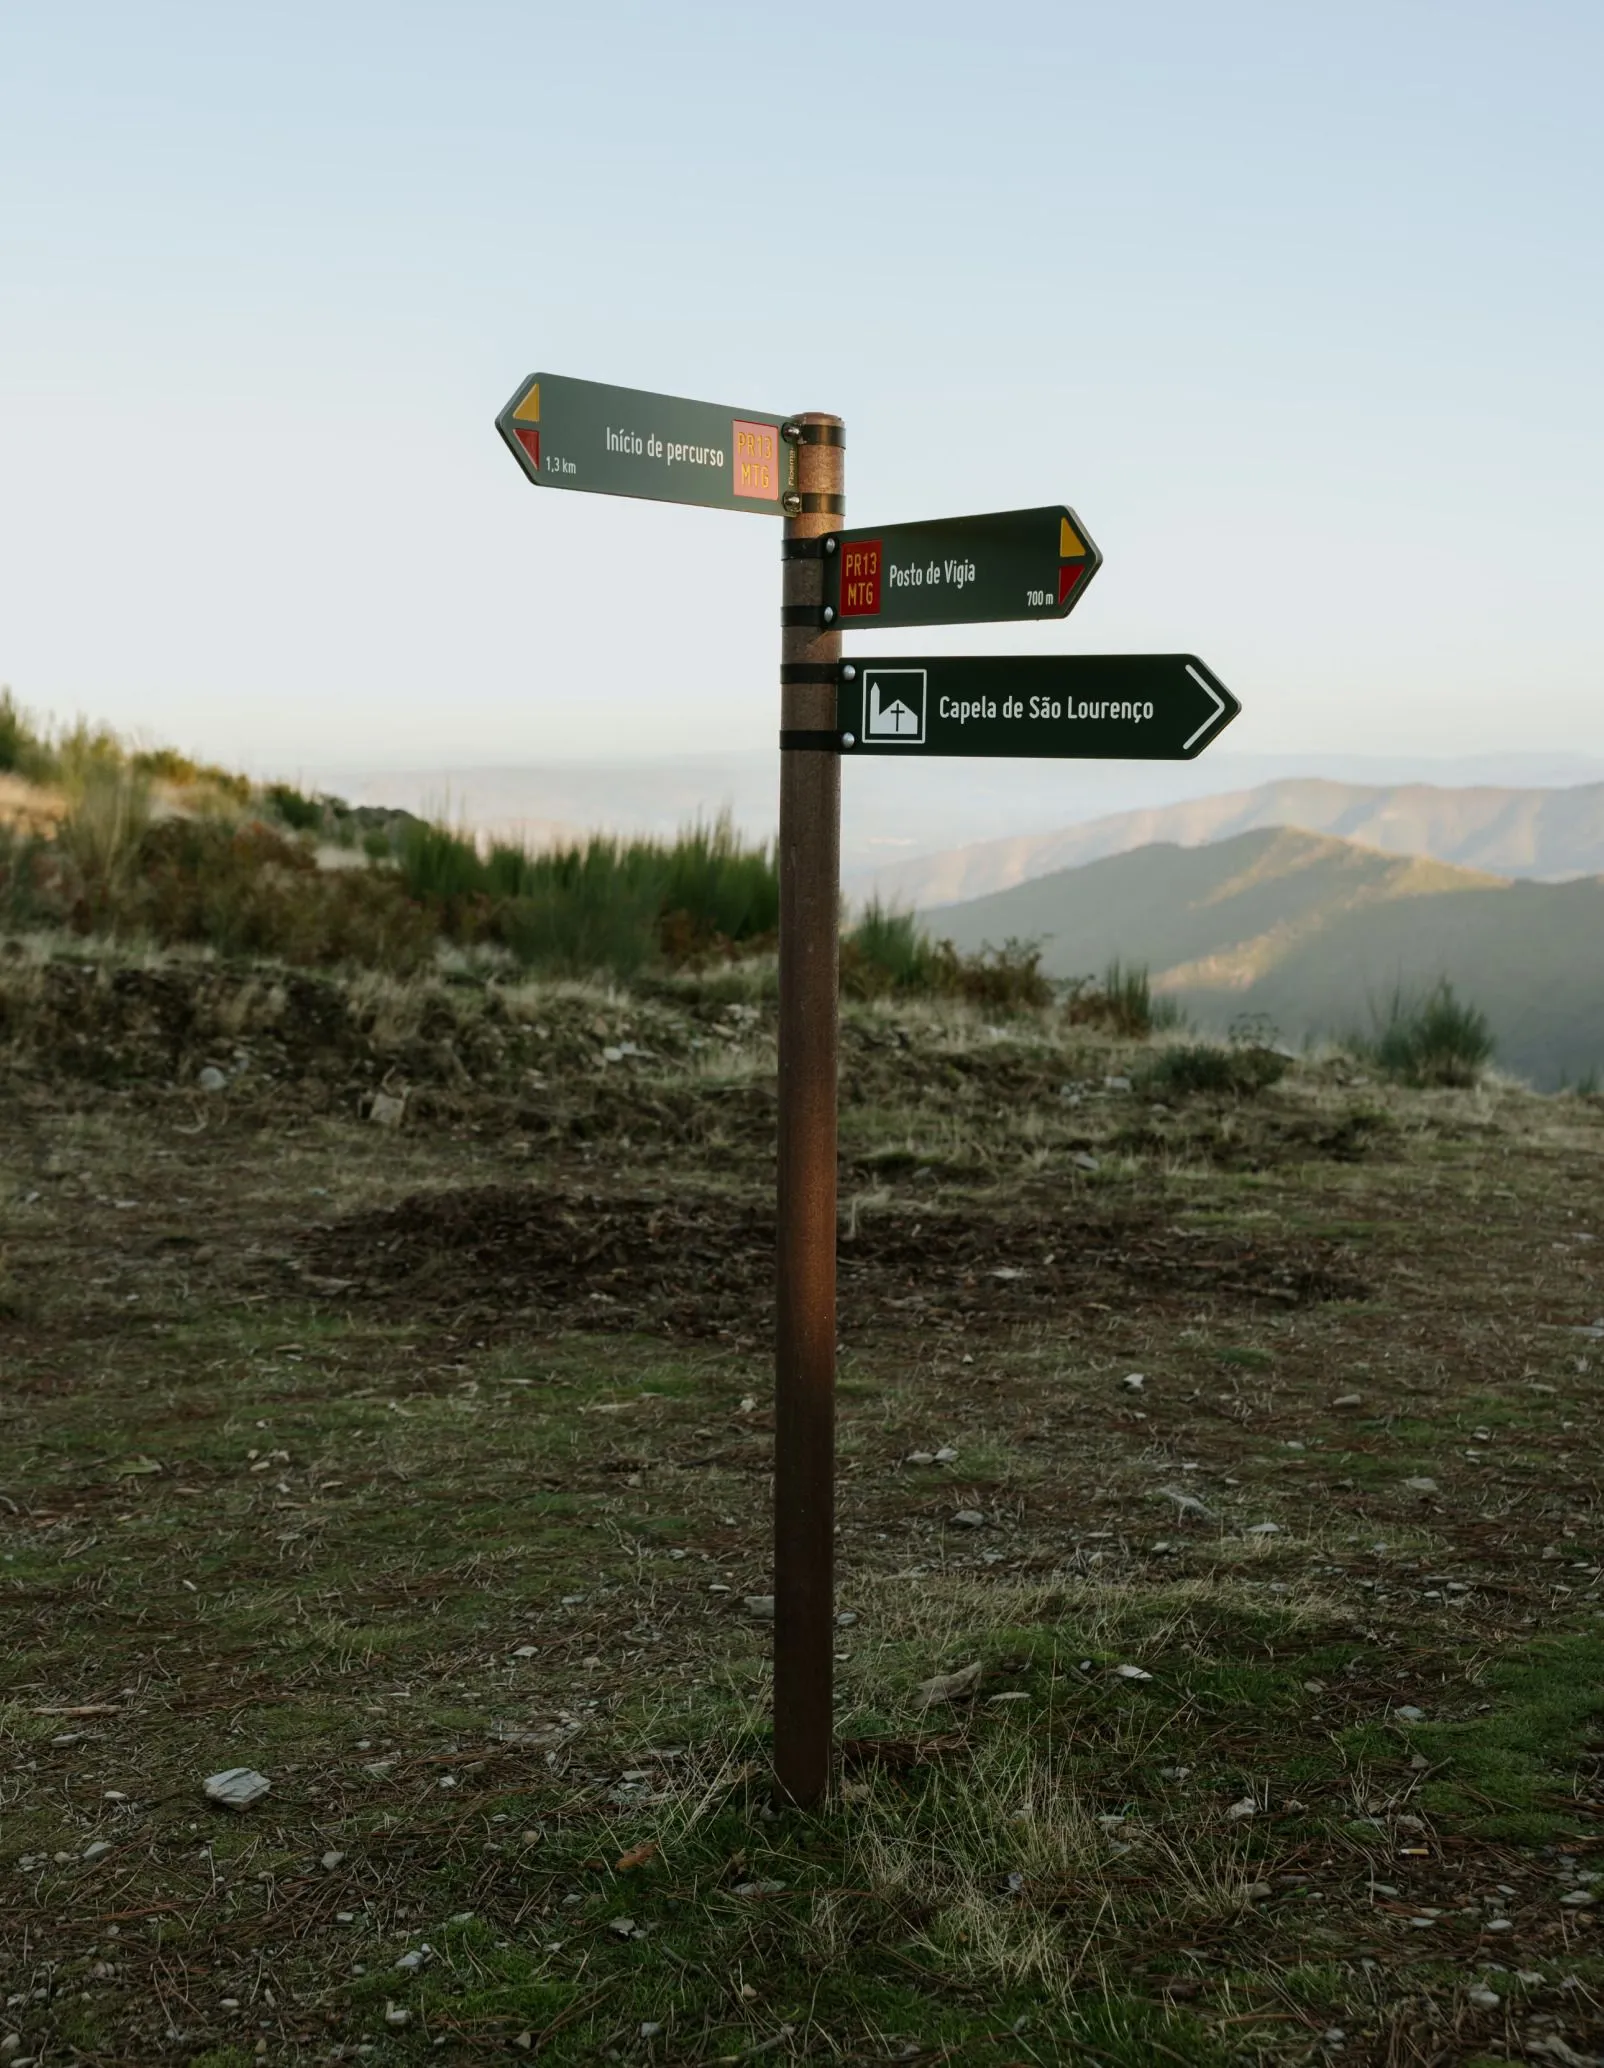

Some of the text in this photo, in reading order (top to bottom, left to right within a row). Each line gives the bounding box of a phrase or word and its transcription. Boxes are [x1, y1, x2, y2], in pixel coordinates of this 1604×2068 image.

[606, 426, 724, 468] Início de percurso
[737, 431, 773, 461] PR13
[545, 455, 577, 475] 1,3 km
[741, 461, 770, 489] MTG
[845, 551, 877, 577] PR13
[889, 558, 976, 590] Posto de Vigia
[847, 581, 874, 606] MTG
[1026, 590, 1054, 607] 700 m
[939, 695, 1154, 725] Capela de São Lourenço
